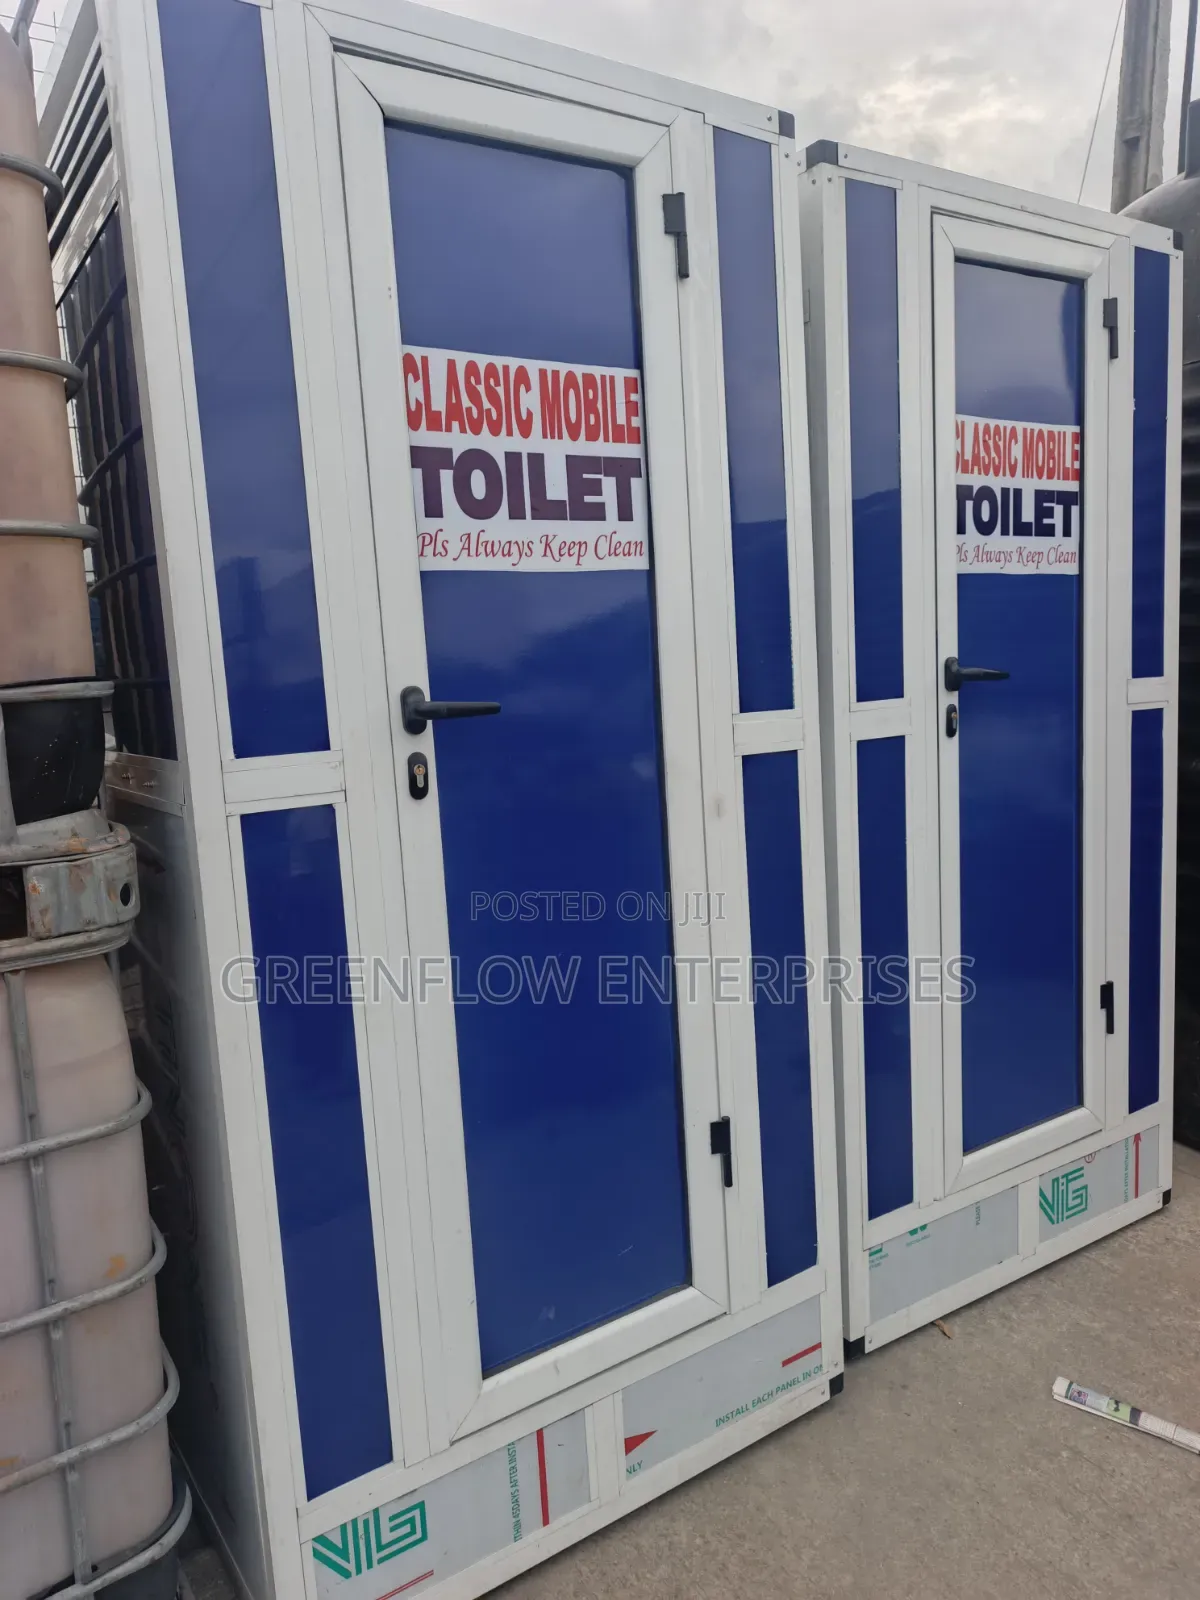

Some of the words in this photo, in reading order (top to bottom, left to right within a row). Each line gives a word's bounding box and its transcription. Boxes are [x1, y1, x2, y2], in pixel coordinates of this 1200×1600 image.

[402, 352, 533, 439] CLASSIC
[538, 368, 642, 444] MOBILE
[1021, 427, 1080, 482] MOBILE
[409, 445, 642, 522] TOILET
[956, 484, 1079, 538] TOILET
[417, 528, 449, 559] Pls
[451, 528, 534, 567] Always
[539, 533, 588, 567] Keep
[593, 530, 645, 561] Clean
[969, 542, 1013, 570] Always
[1015, 545, 1044, 570] Keep
[1046, 543, 1077, 566] Clean
[714, 1403, 750, 1428] INSTALL
[751, 1390, 774, 1409] EACH
[775, 1376, 802, 1396] PANEL
[802, 1369, 812, 1381] IN
[508, 1463, 519, 1488] AFTER
